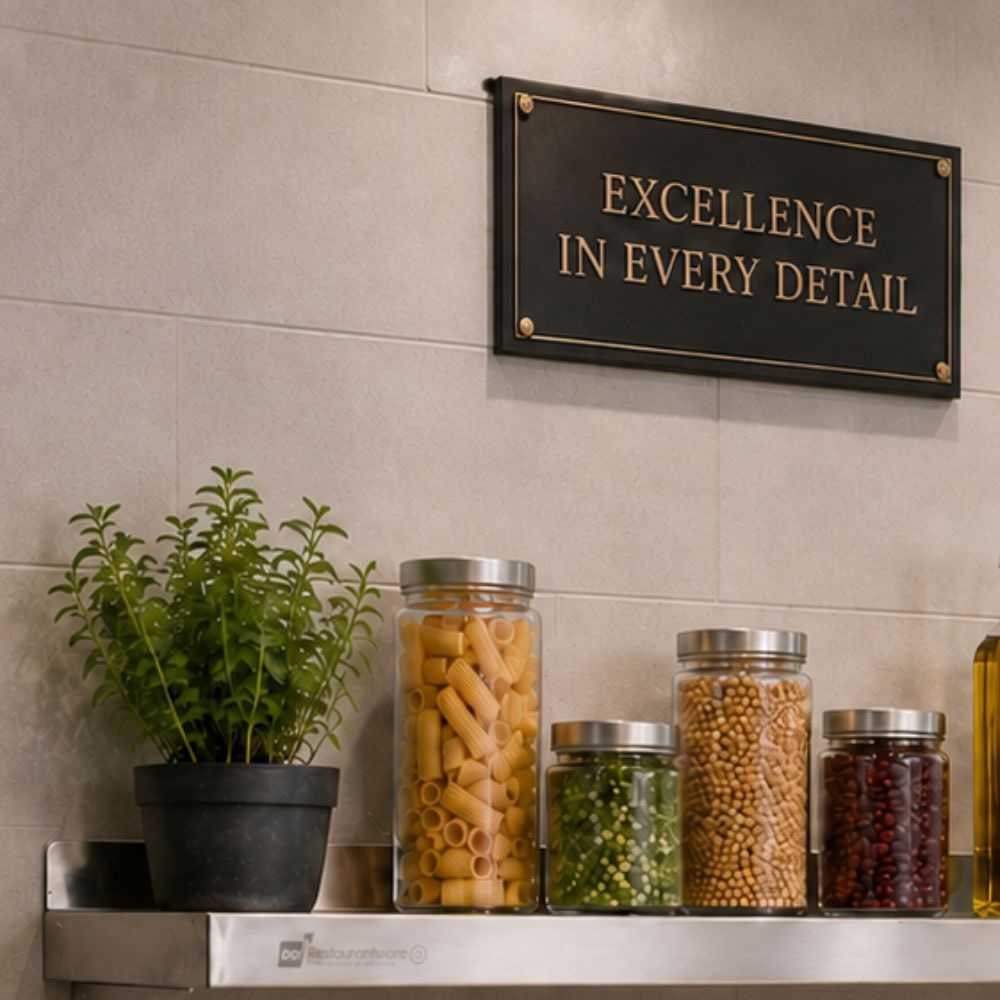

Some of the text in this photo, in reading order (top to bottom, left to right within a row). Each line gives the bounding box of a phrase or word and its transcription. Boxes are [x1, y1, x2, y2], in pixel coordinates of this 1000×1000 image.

[602, 172, 877, 248] EXCELLENCE
[558, 232, 918, 315] IN EVERY DETAIL
